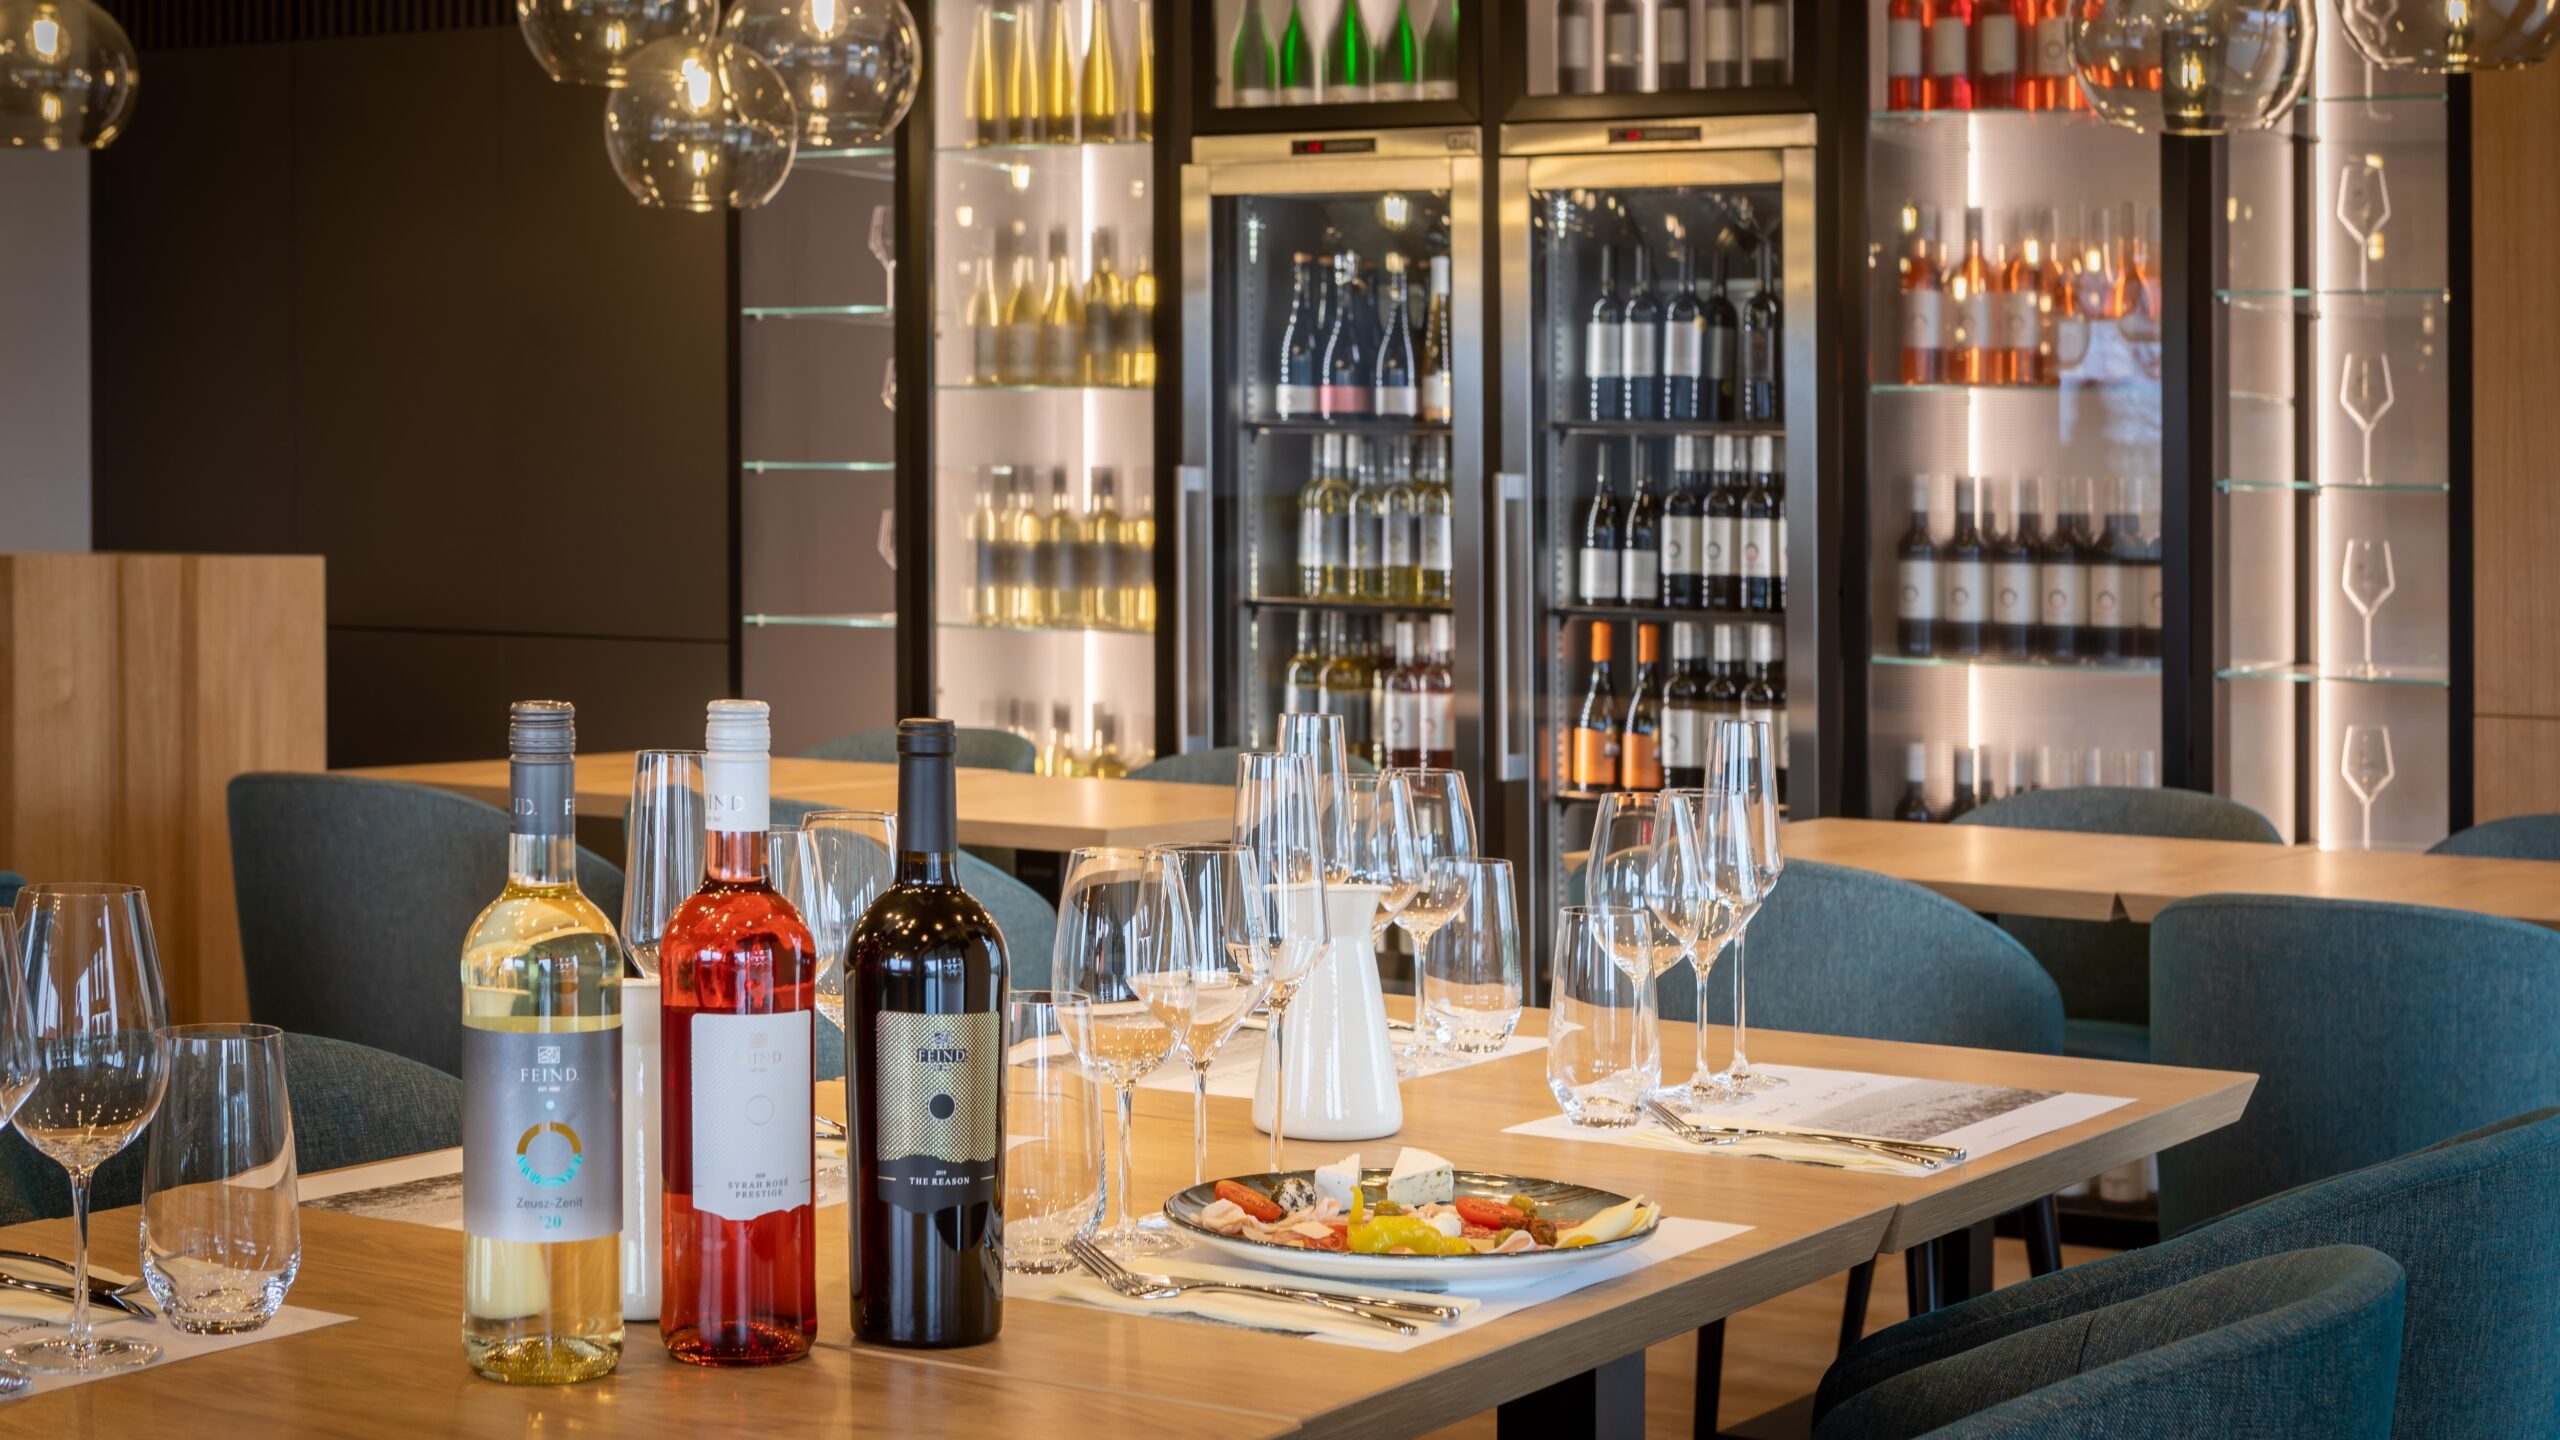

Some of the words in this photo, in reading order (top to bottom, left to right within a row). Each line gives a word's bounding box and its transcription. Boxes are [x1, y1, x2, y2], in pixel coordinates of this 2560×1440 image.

[705, 794, 748, 811] IND.
[728, 1180, 763, 1190] SYRAH
[766, 1177, 789, 1188] ROSÉ
[909, 1177, 929, 1186] THE
[931, 1176, 970, 1186] REASON
[735, 1188, 783, 1199] PRESTIGE
[516, 1196, 583, 1209] Zeusz-Zenit
